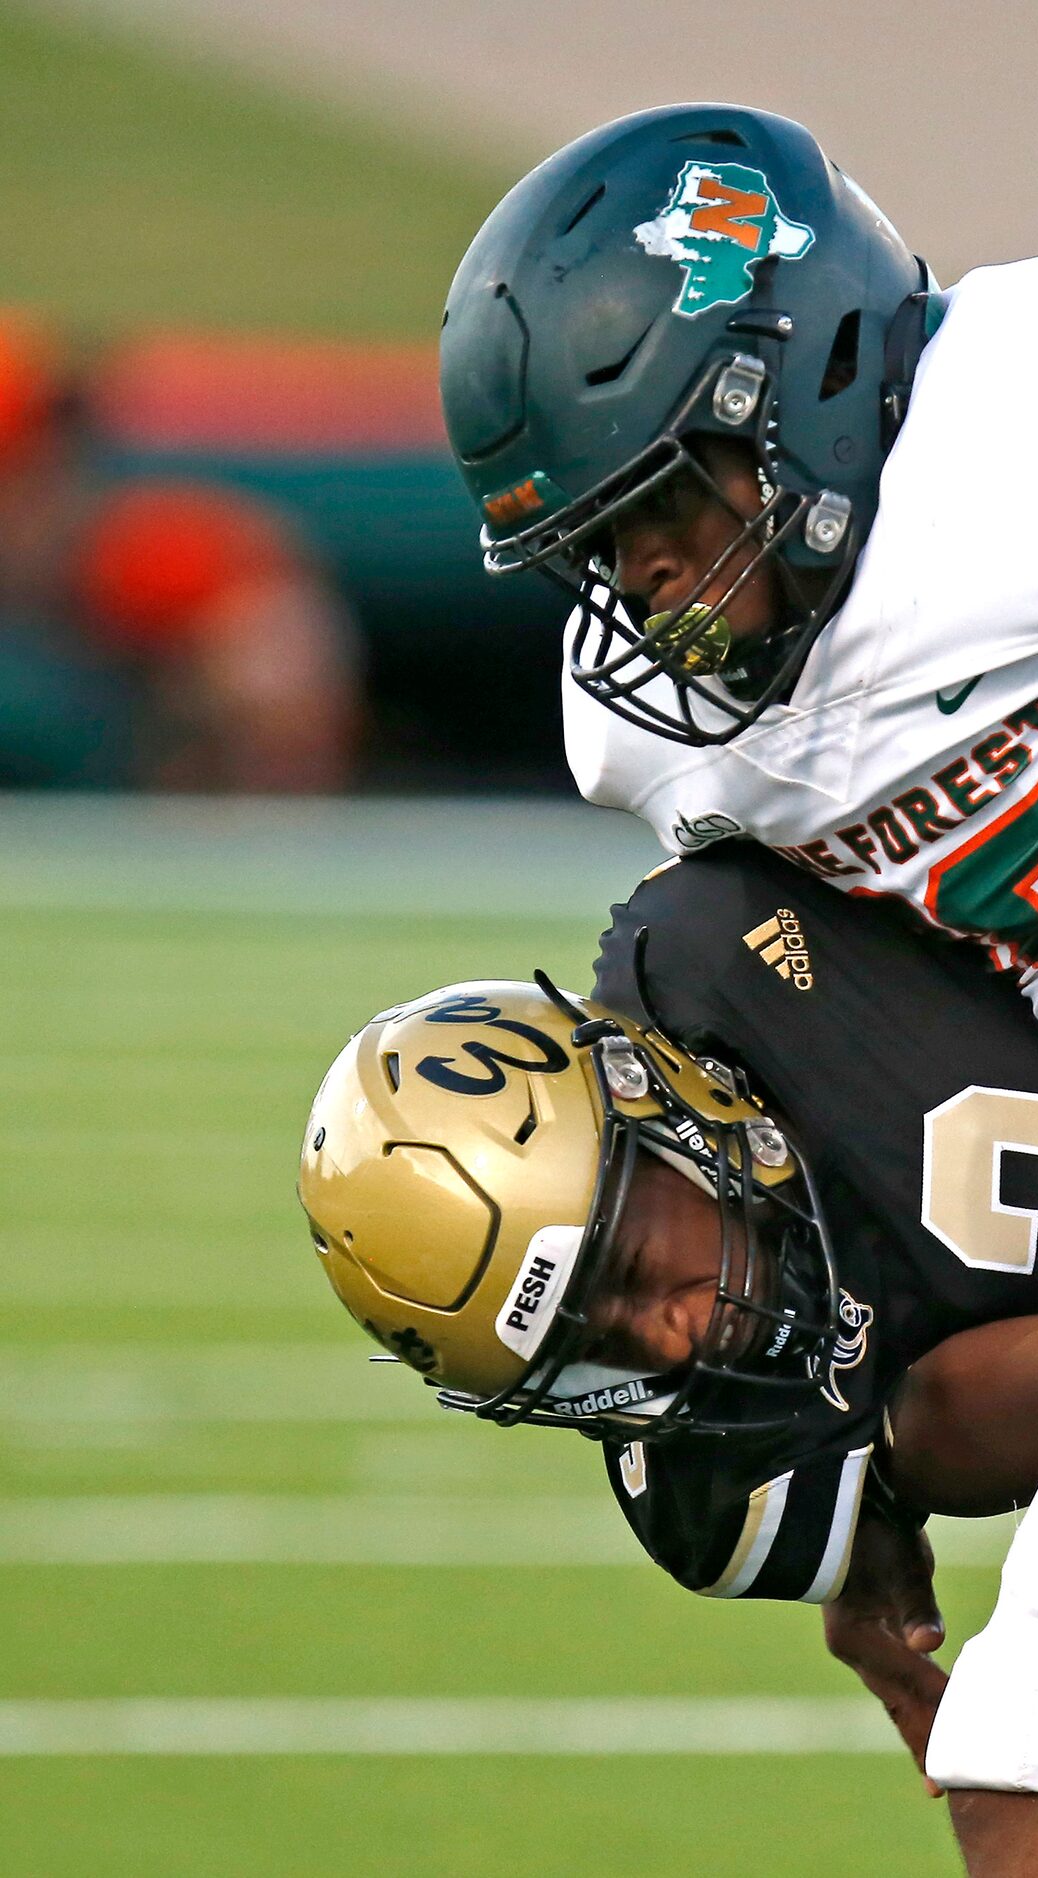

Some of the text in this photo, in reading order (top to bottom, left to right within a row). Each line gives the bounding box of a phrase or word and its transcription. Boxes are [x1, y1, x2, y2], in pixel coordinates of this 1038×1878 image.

[689, 177, 769, 252] N
[777, 909, 814, 990] adidas
[505, 1256, 556, 1332] PESH
